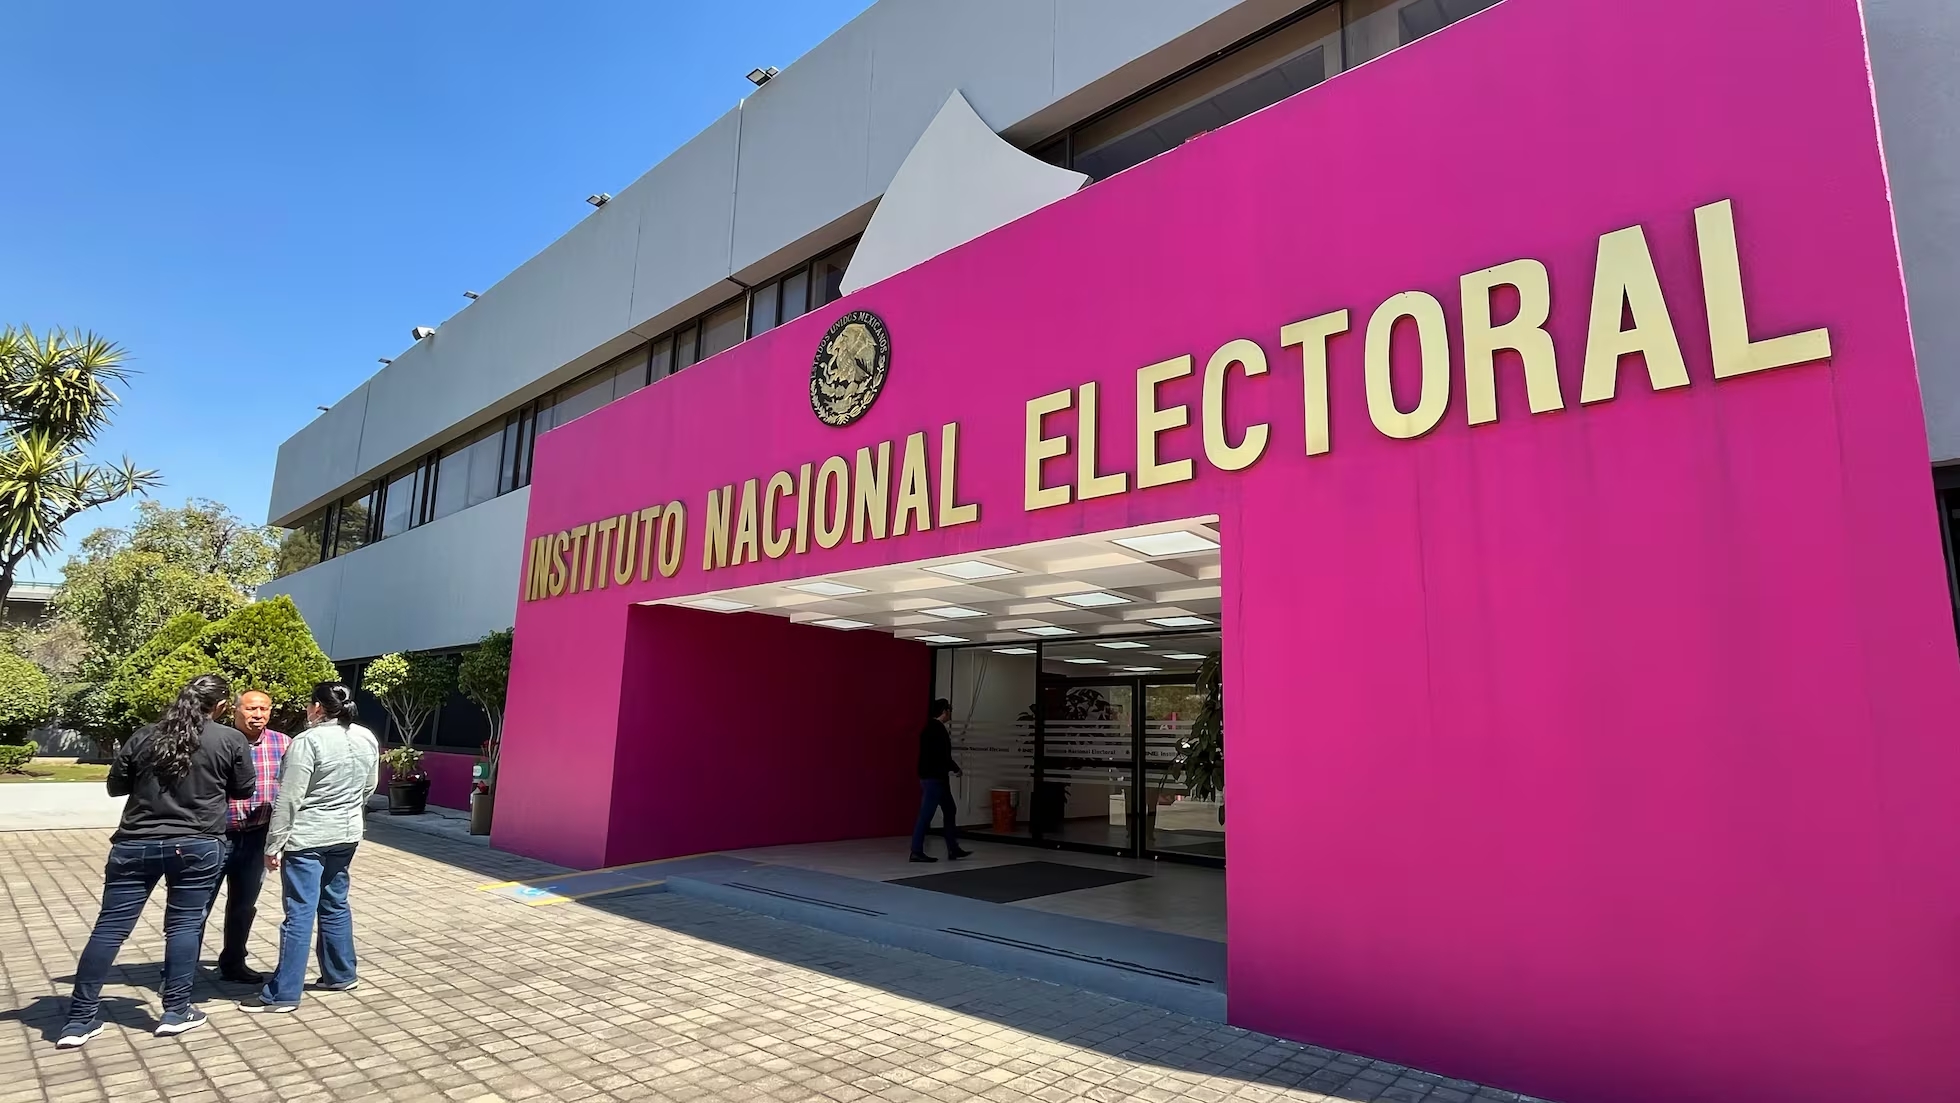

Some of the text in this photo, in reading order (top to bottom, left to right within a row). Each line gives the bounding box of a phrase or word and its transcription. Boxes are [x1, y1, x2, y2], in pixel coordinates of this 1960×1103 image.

[524, 198, 1832, 602] INSTITUTO NACIONAL ELECTORAL
[810, 311, 889, 379] ESTADOS UNIDOS MEXICANOS
